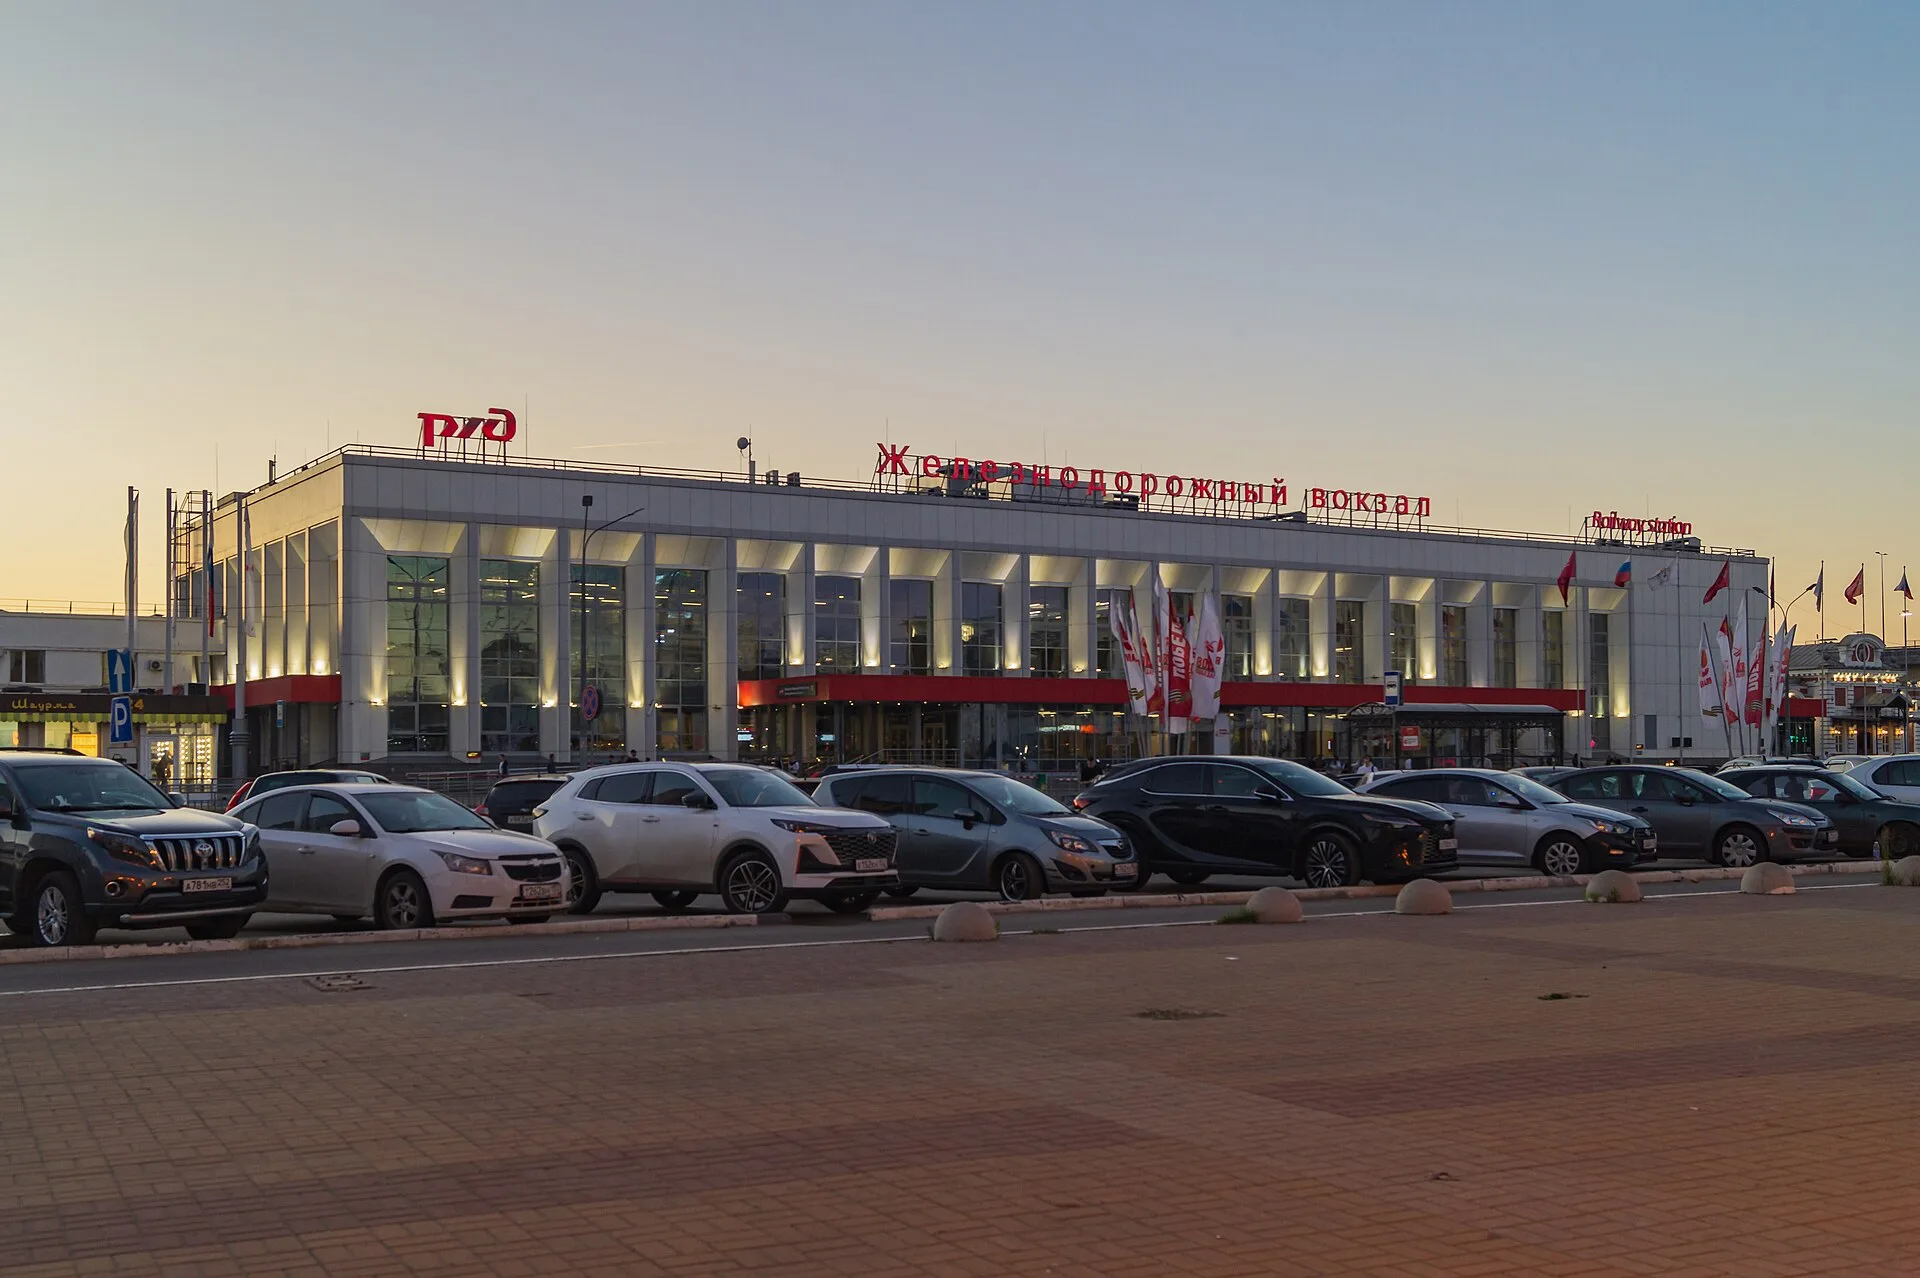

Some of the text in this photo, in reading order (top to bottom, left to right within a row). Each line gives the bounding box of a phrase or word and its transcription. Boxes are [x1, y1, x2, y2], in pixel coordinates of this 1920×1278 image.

[877, 442, 1430, 517] Железнодорожный вокзал
[1592, 510, 1692, 535] Railway station
[11, 698, 145, 711] Шаурма 4
[114, 703, 127, 738] P
